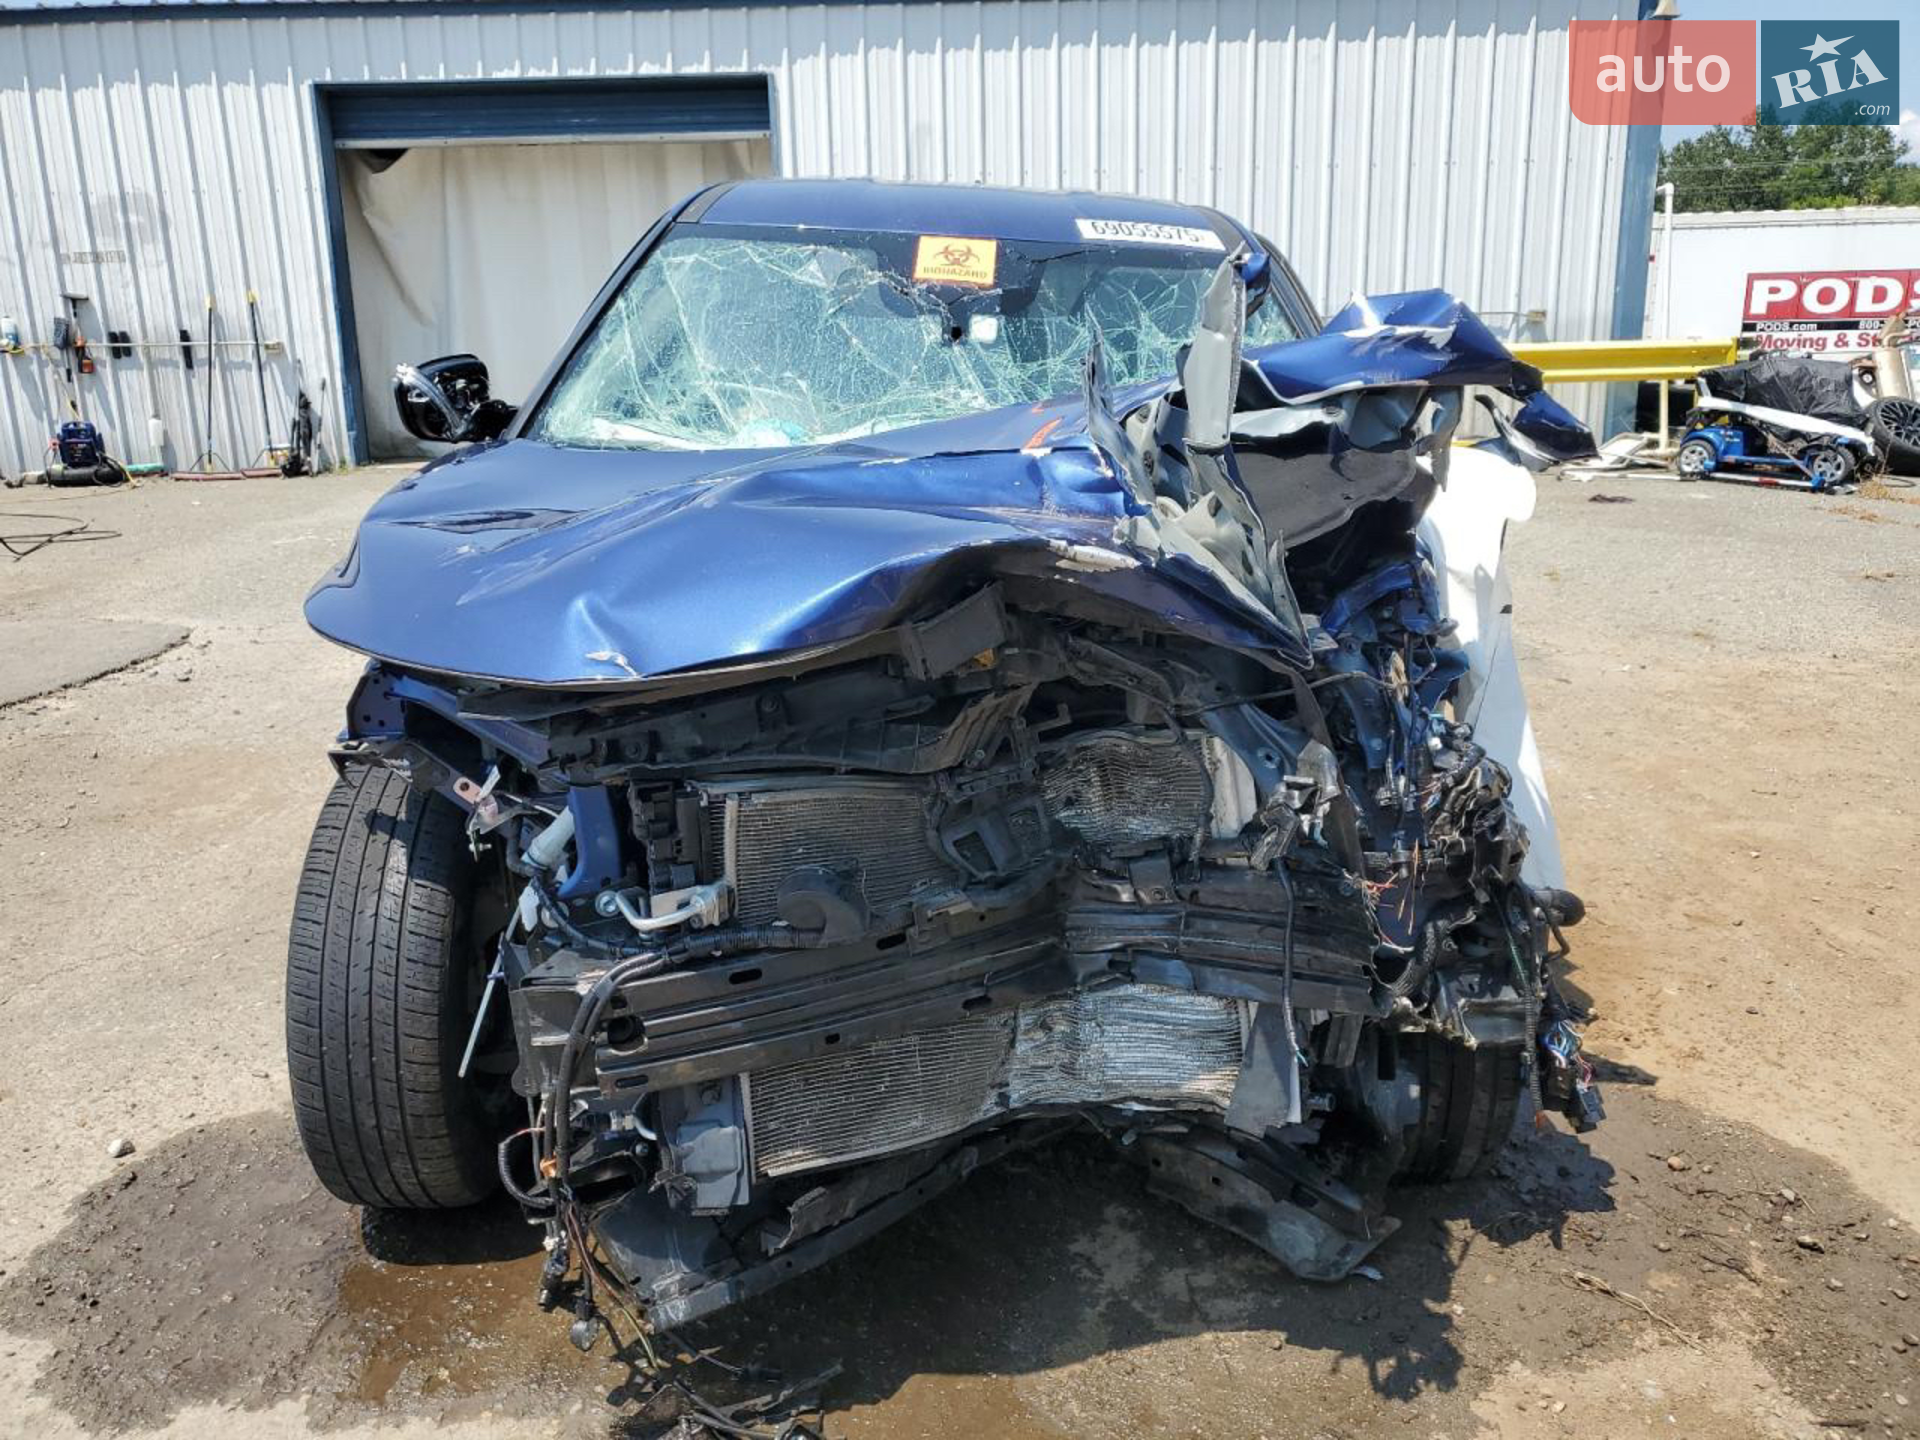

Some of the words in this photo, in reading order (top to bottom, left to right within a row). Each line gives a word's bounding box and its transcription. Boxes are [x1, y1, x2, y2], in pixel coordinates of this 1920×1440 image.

[1091, 221, 1200, 243] 69055575
[923, 266, 988, 278] BIOHAZARD
[1749, 277, 1920, 315] POD
[1756, 321, 1818, 332] PODS.com
[1756, 334, 1828, 351] Moving
[1834, 332, 1849, 348] &
